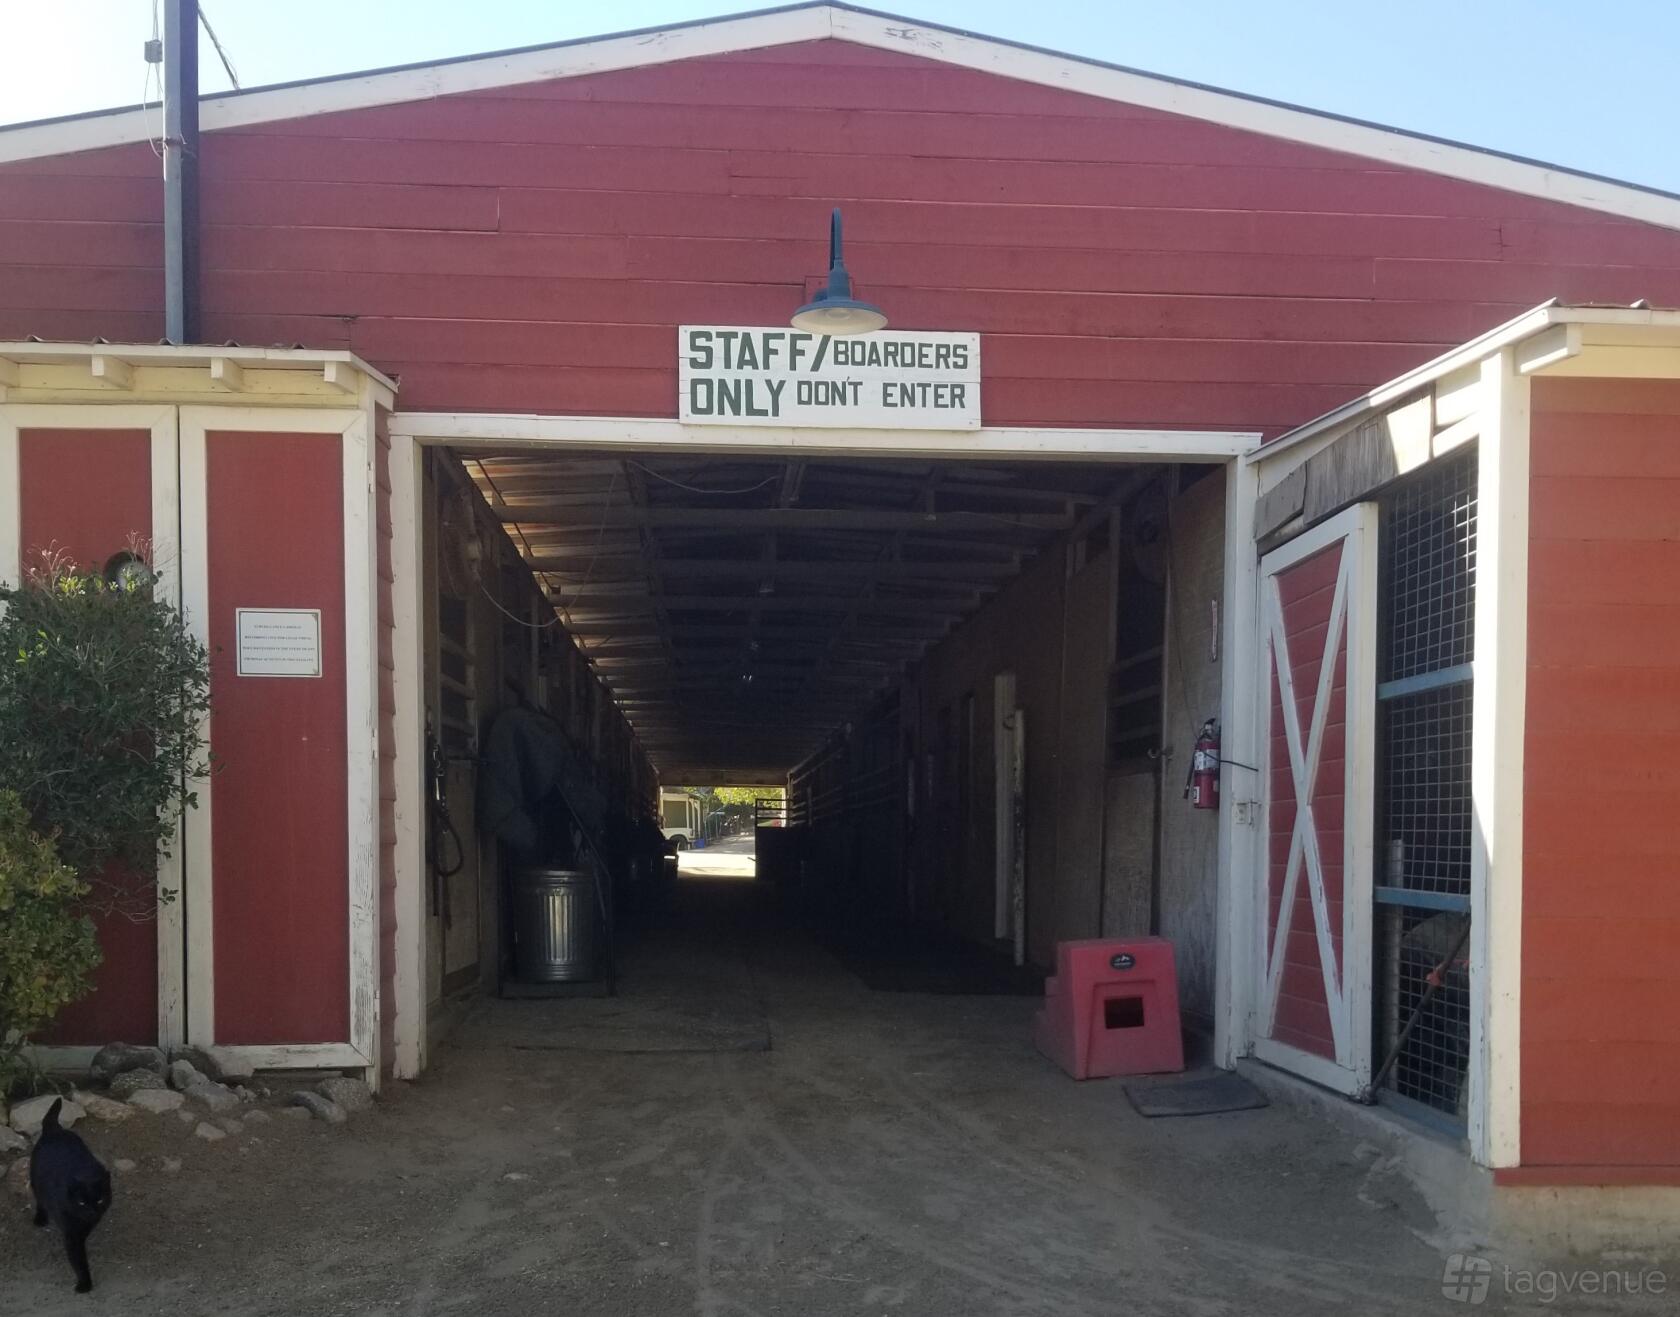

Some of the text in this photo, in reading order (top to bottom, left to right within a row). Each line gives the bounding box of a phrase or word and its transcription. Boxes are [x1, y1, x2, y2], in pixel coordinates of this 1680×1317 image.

[690, 377, 965, 417] ONLY DON'T ENTER
